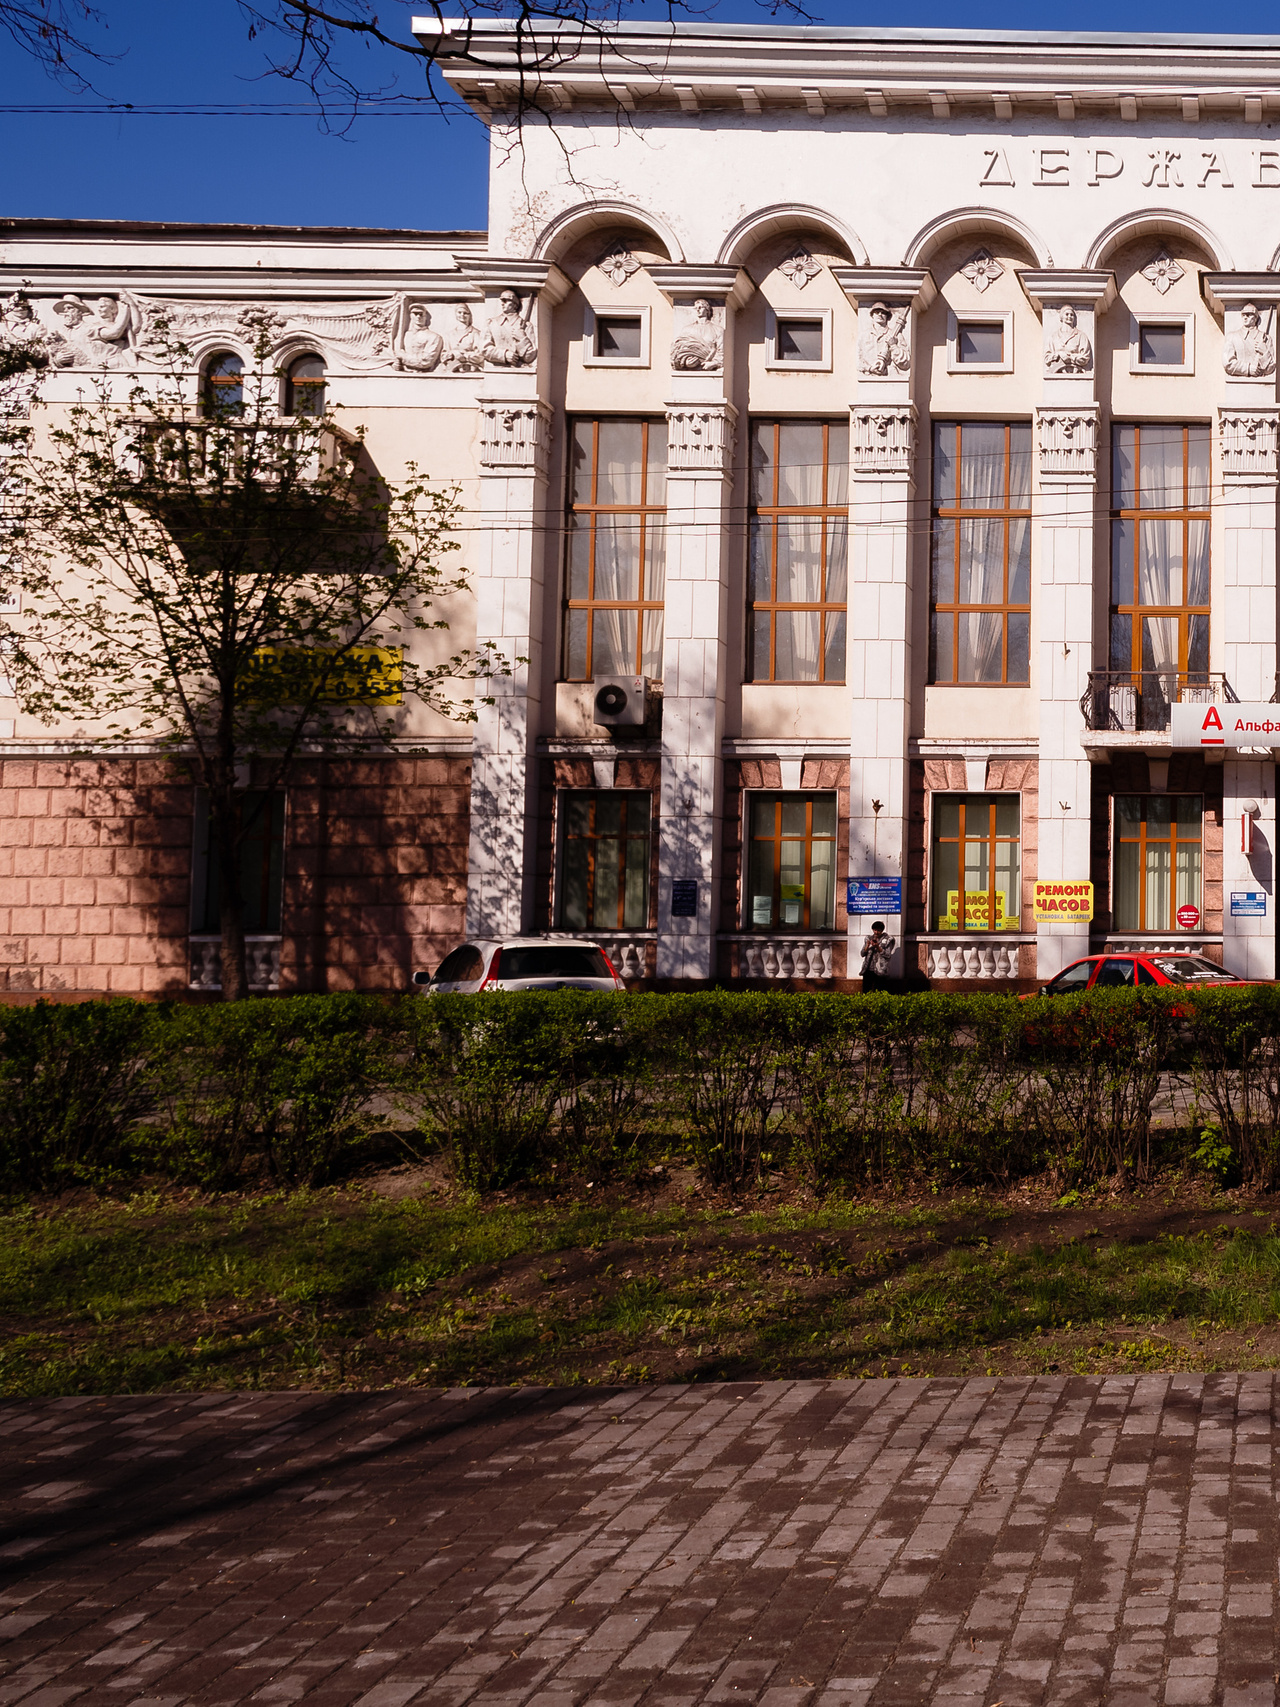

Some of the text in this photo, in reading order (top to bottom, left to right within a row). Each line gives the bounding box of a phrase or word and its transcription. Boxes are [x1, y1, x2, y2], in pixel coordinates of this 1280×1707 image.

[1036, 885, 1090, 896] РЕМОНТ
[951, 895, 1003, 905] РМОТ
[1036, 899, 1090, 911] ЧАСОВ
